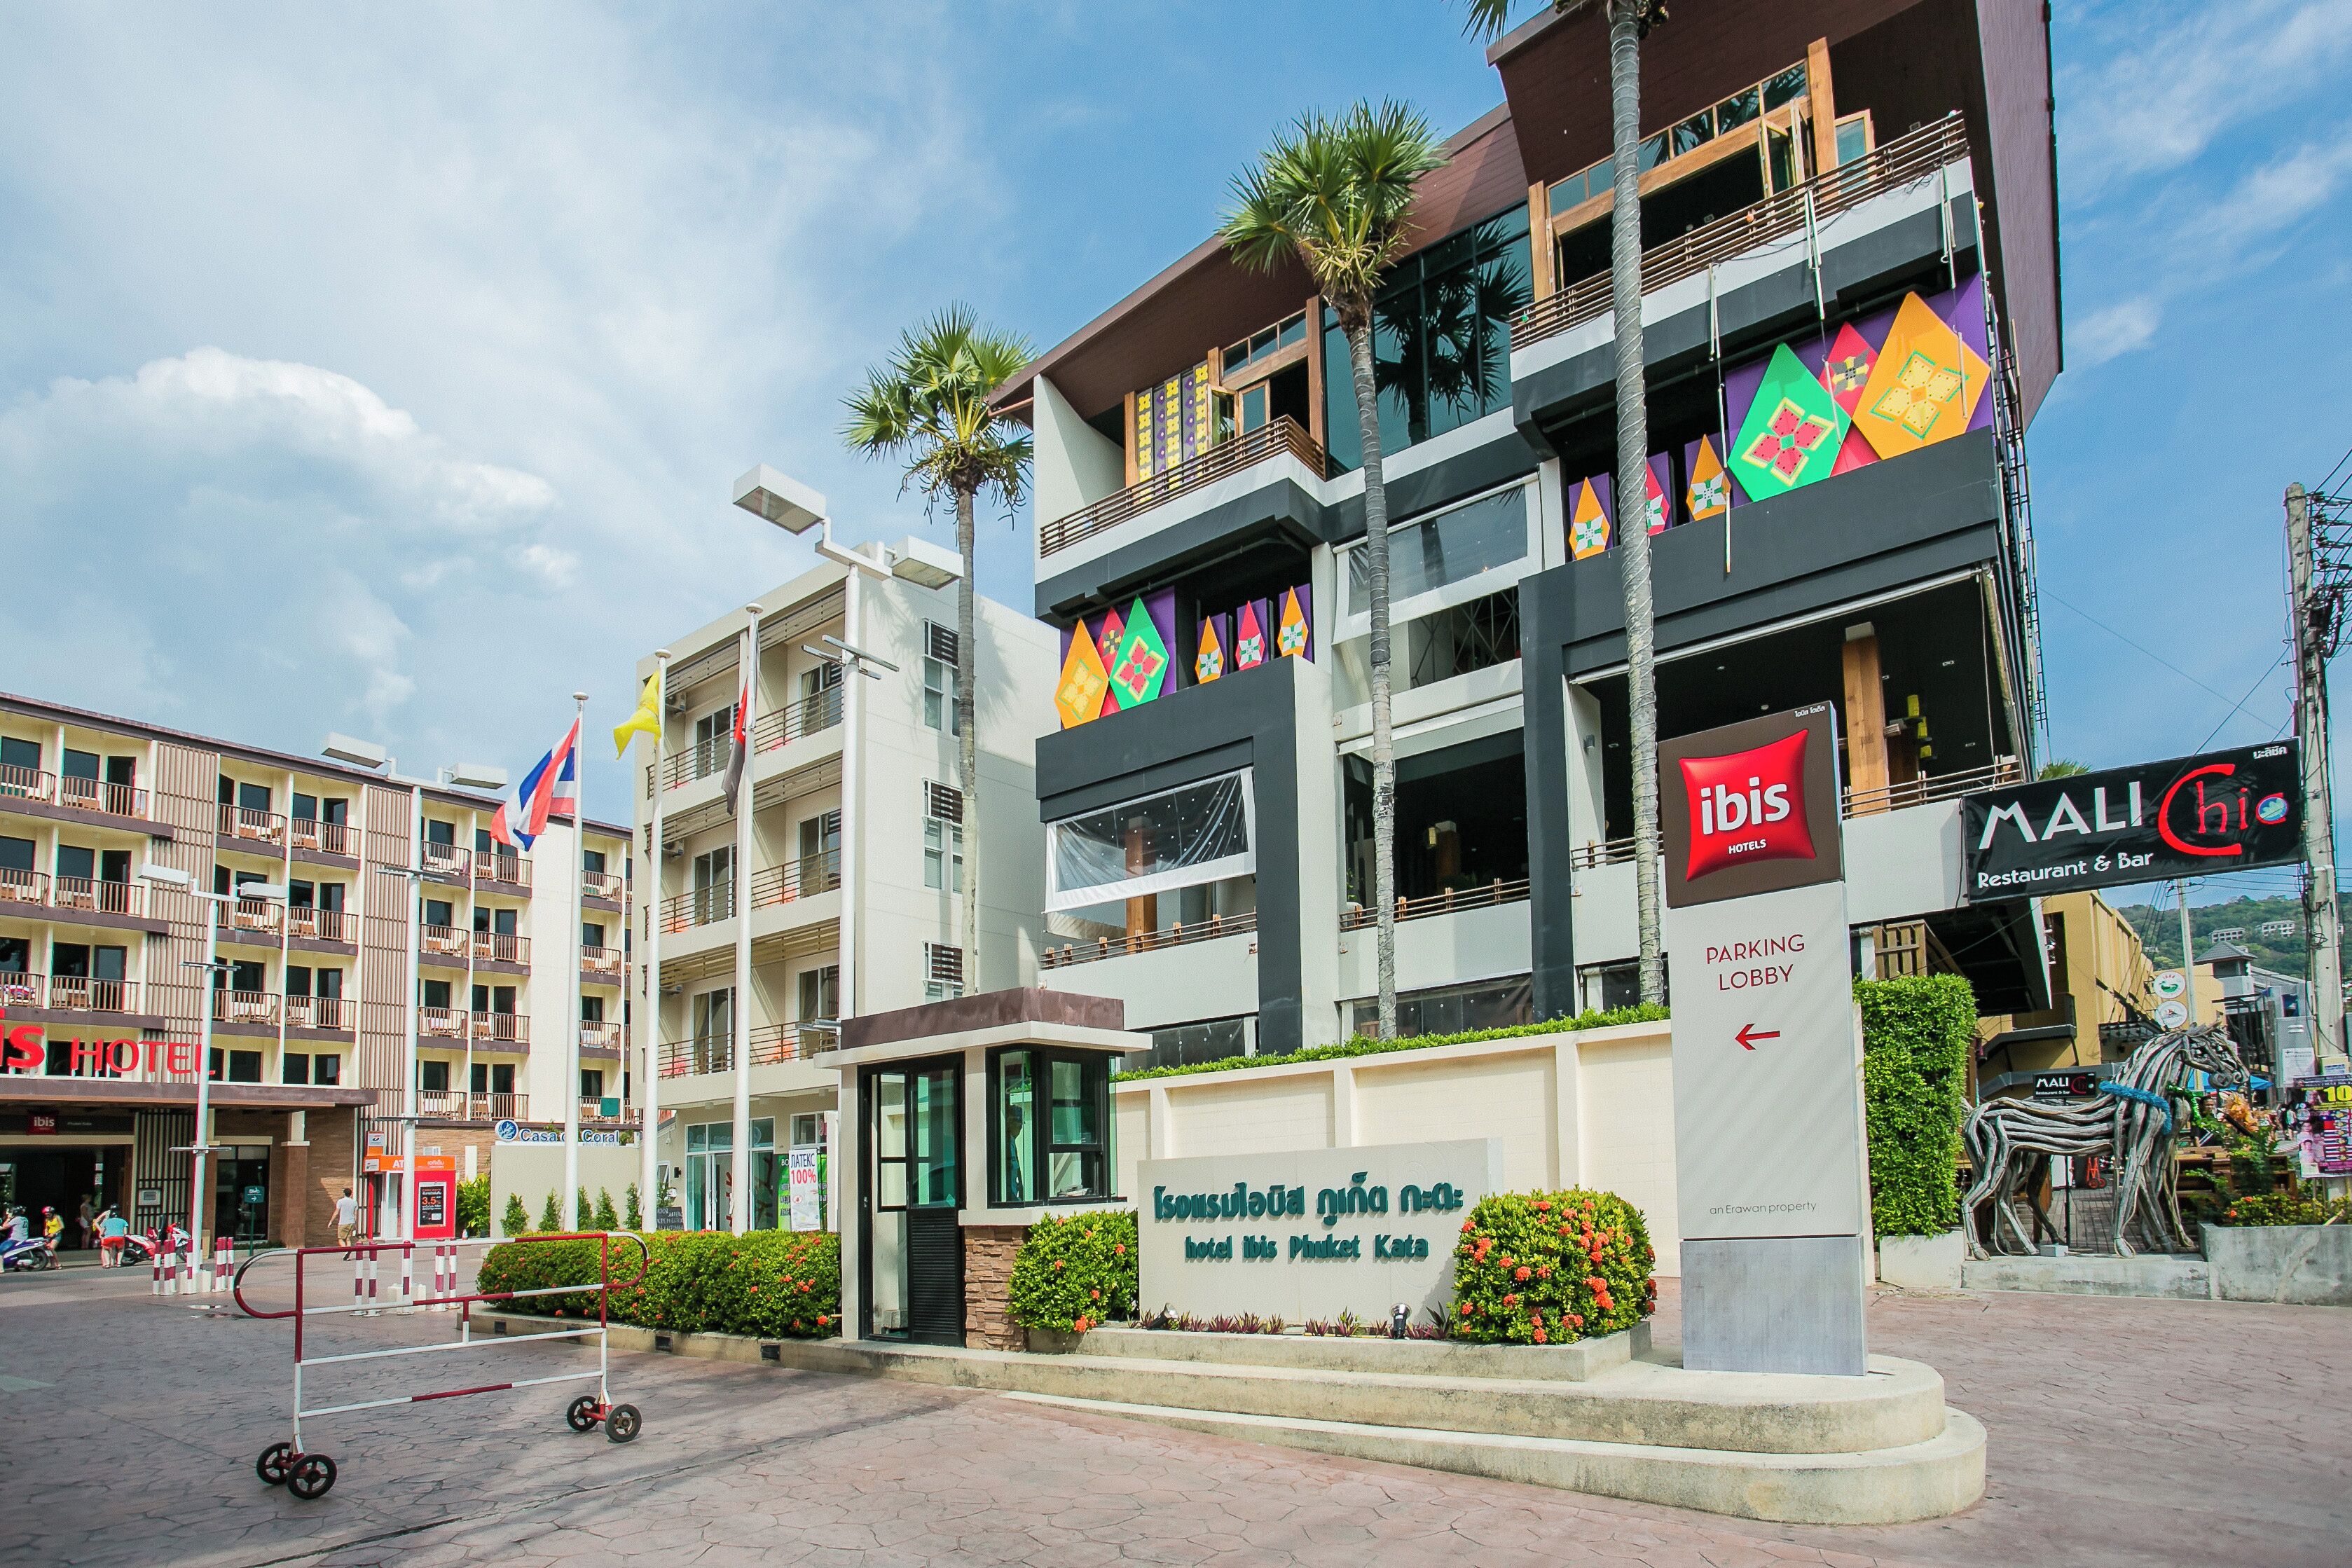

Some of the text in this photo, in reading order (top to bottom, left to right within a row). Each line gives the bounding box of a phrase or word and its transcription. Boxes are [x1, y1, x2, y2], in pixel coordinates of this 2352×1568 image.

[1700, 776, 1790, 835] ibis
[1978, 763, 2289, 856] MALI Chic
[1728, 839, 1767, 855] HOTELS
[1977, 852, 2154, 888] Restaurant & Bar
[1705, 934, 1805, 965] PARKING
[1719, 963, 1794, 991] LOBBY
[71, 1035, 216, 1075] HOTEL
[2036, 1077, 2069, 1088] MALI
[34, 1117, 55, 1127] ibis
[521, 1129, 558, 1142] Casa
[582, 1130, 619, 1143] Coral
[392, 1160, 404, 1169] AT
[791, 1153, 816, 1168] ЛАТЕКС
[791, 1169, 817, 1184] 100%
[1154, 1172, 1464, 1225] โรงแรมไอบิส ภูเก็ต กะตะ
[1726, 1204, 1766, 1214] Erawan
[1768, 1201, 1817, 1213] property
[1185, 1234, 1429, 1259] hotel ibis Phuket Kata
